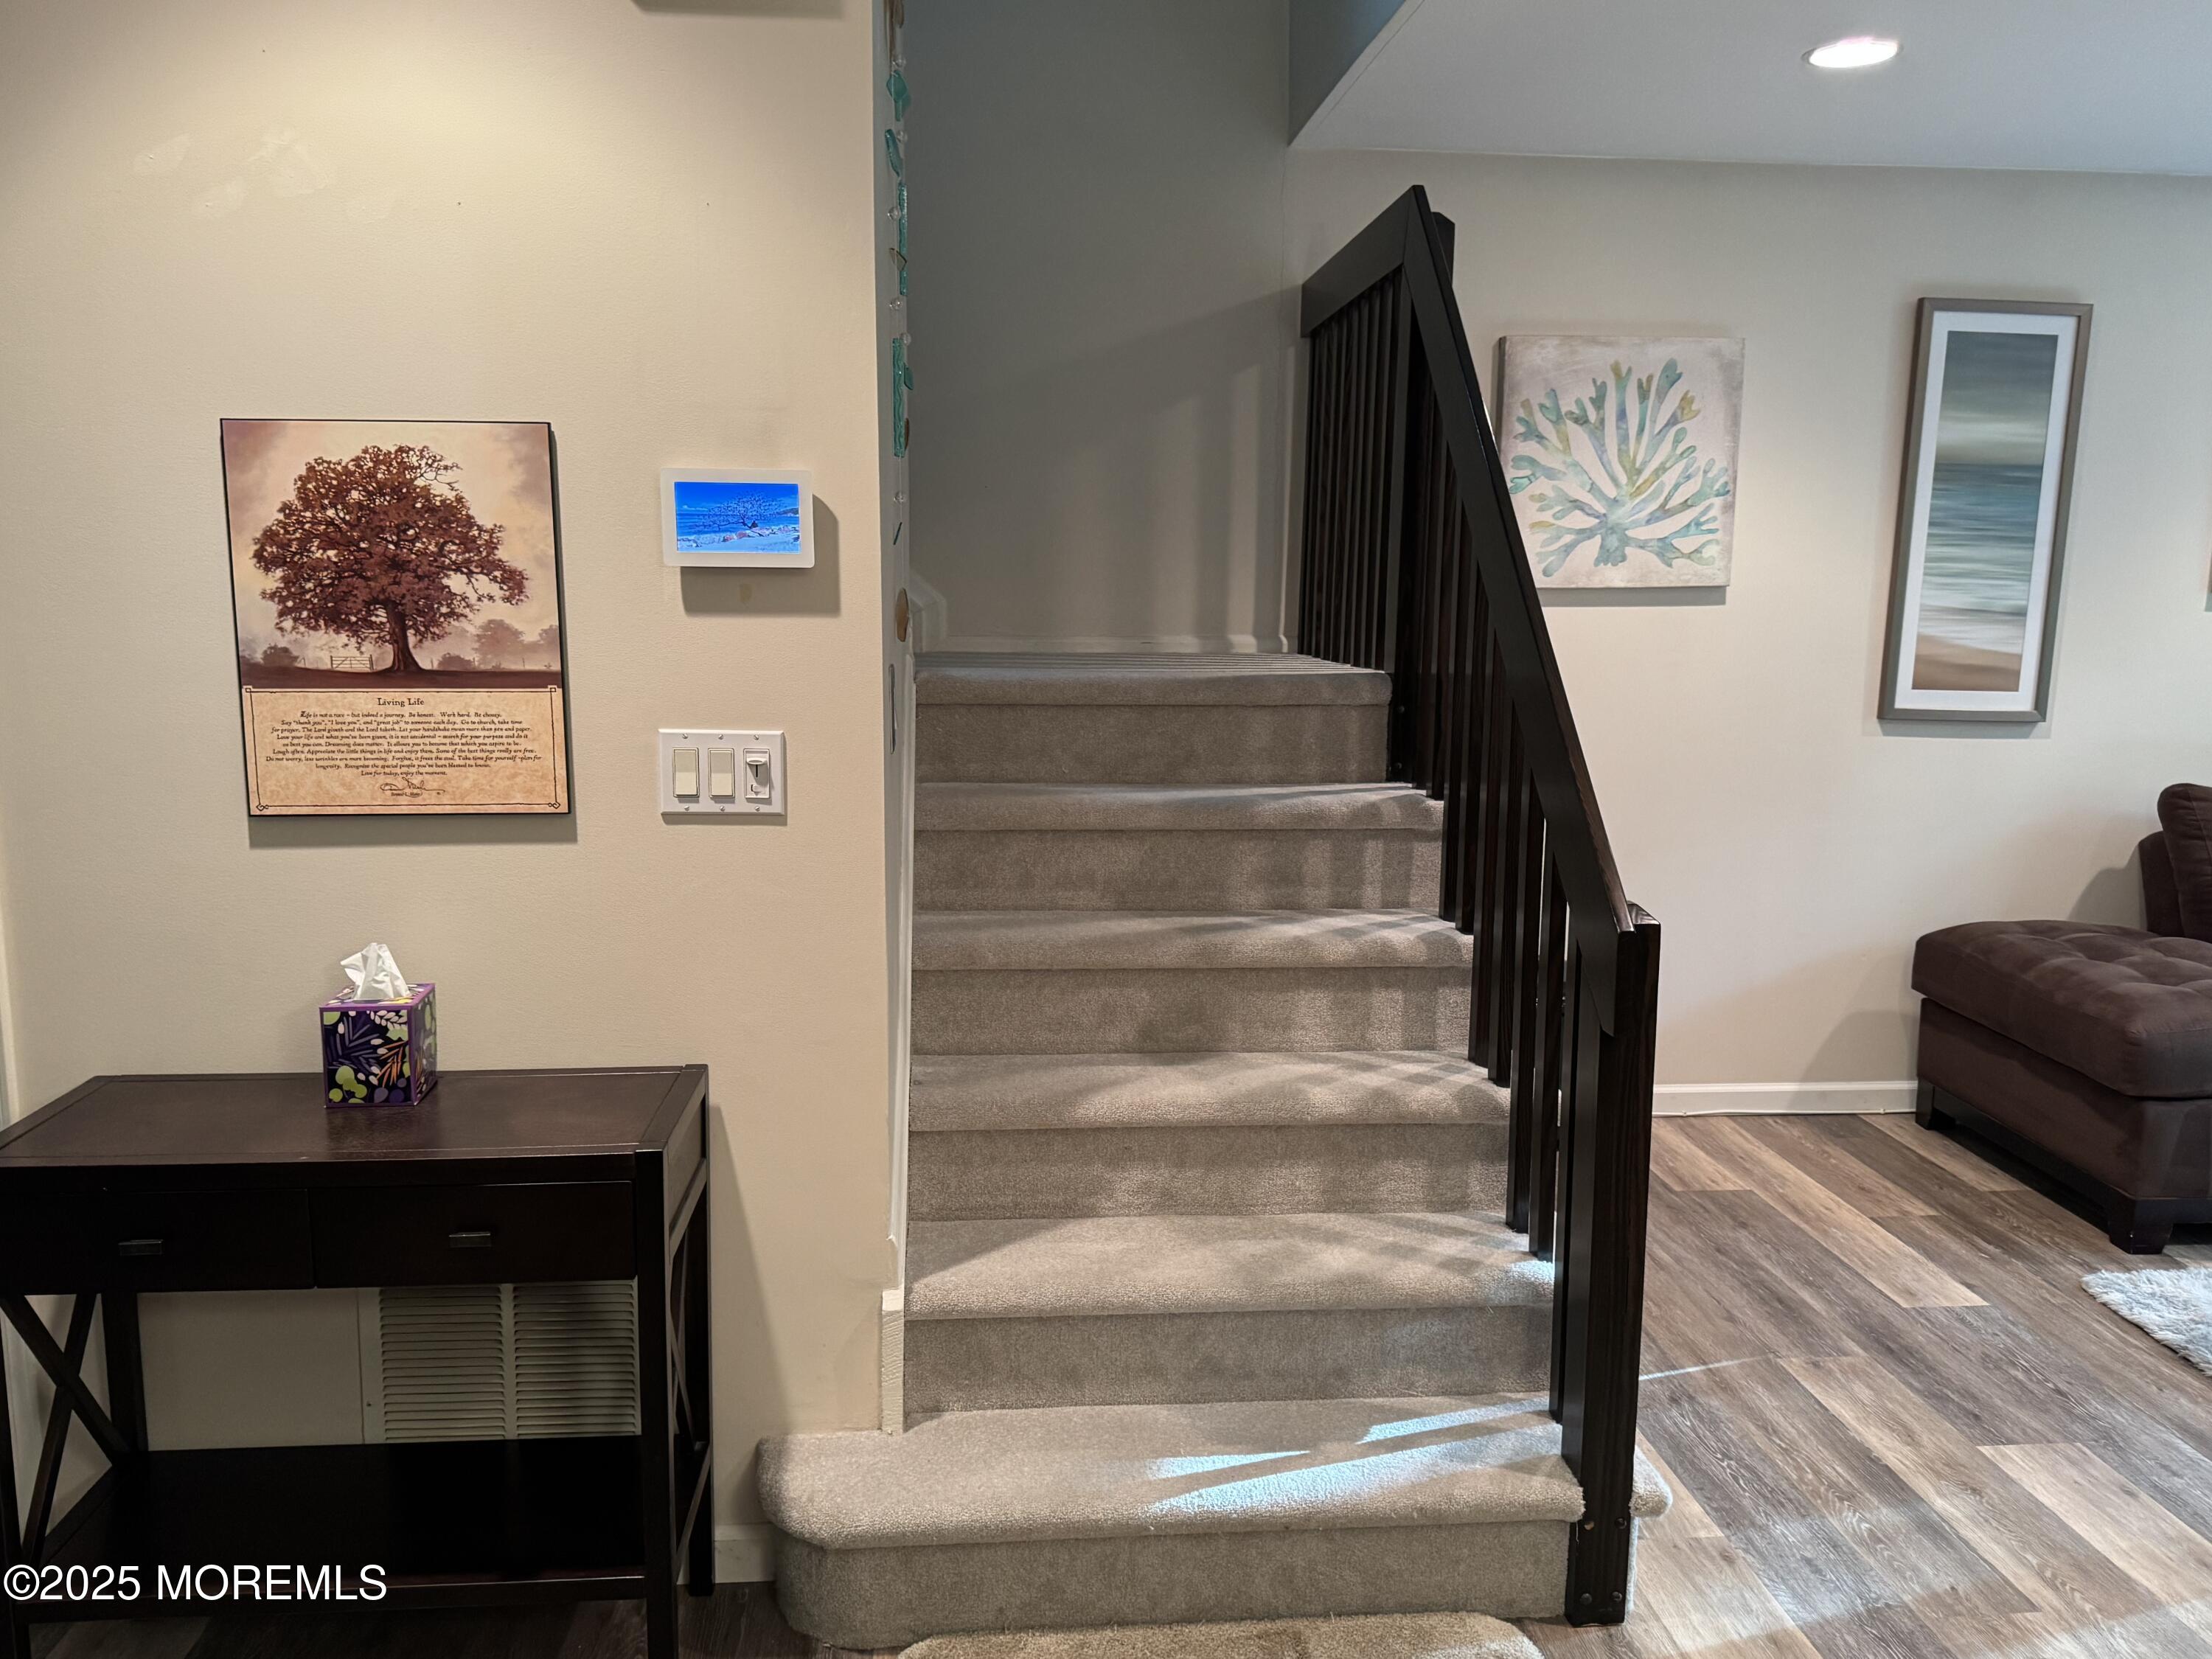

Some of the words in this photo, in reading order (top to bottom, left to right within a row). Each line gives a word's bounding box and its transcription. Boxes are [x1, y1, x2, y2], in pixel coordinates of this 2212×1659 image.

[377, 698, 406, 707] Living
[407, 698, 425, 706] Life
[300, 711, 312, 719] Life
